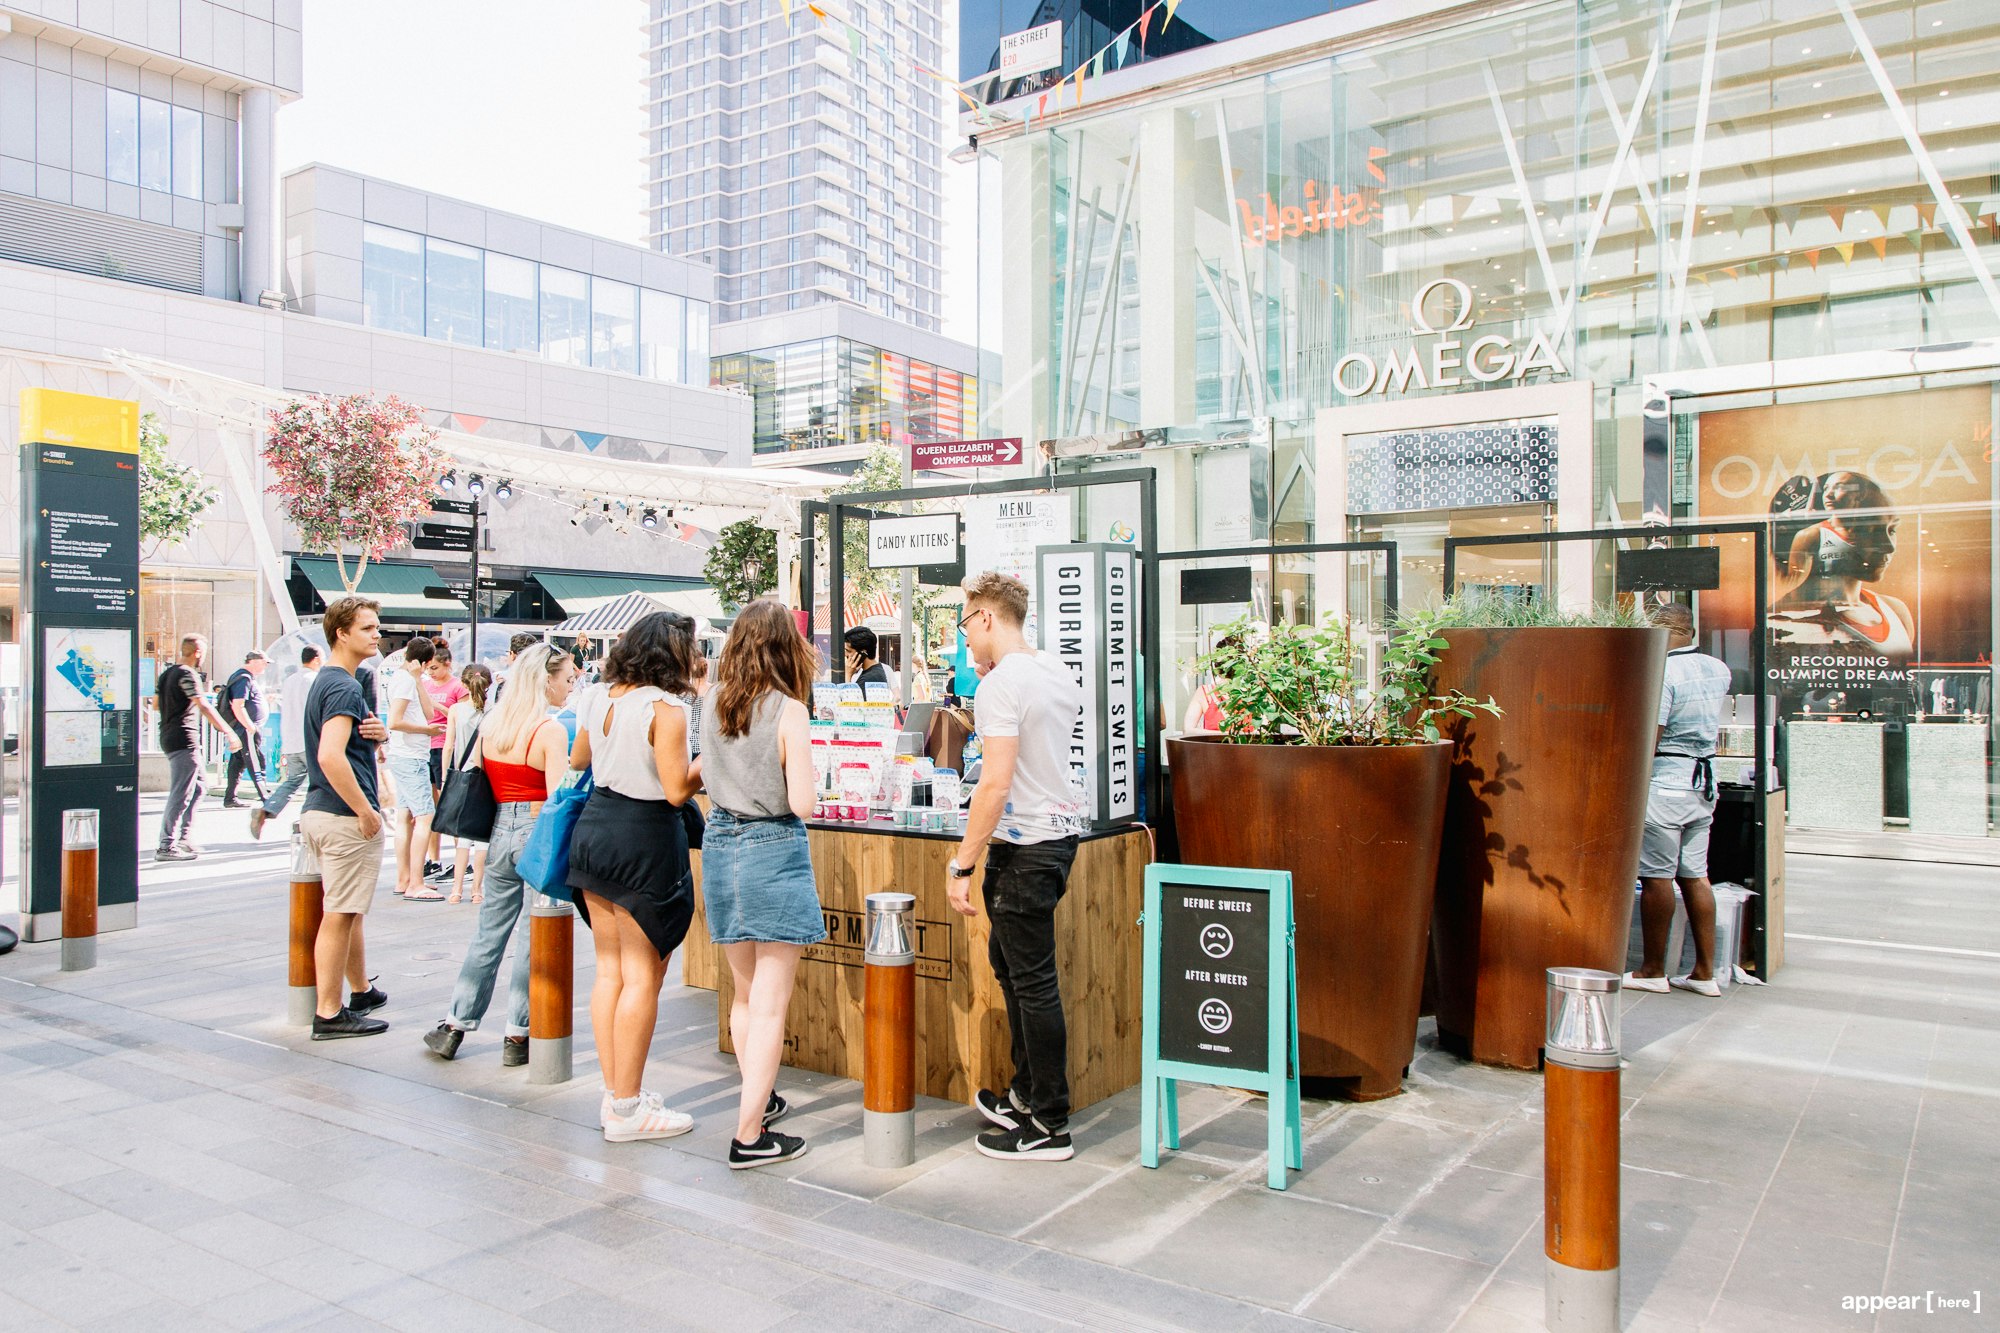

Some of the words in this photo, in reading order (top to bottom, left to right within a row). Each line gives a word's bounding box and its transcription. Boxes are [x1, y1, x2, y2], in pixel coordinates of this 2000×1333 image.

[1004, 37, 1017, 50] THE
[1020, 28, 1048, 45] STREET
[1333, 329, 1567, 397] OMEGA
[916, 446, 946, 455] QUEEN
[948, 443, 994, 453] ELIZABETH
[932, 456, 969, 465] OLYMPIC
[972, 454, 994, 463] PARK
[1711, 440, 1978, 498] OMEGA
[1000, 502, 1032, 517] MENU
[877, 535, 906, 549] CANDY
[910, 533, 948, 548] KITTENS
[1111, 566, 1124, 687] GOURMET
[1791, 656, 1889, 667] RECORDING
[1768, 669, 1838, 680] OLYMPIC
[1844, 670, 1914, 681] DREAMS
[1111, 704, 1127, 804] SWEETS
[1183, 897, 1215, 910] BEFORE
[1218, 900, 1252, 912] SWEETS
[1185, 970, 1211, 982] AFTER
[1214, 973, 1248, 986] SWEETS
